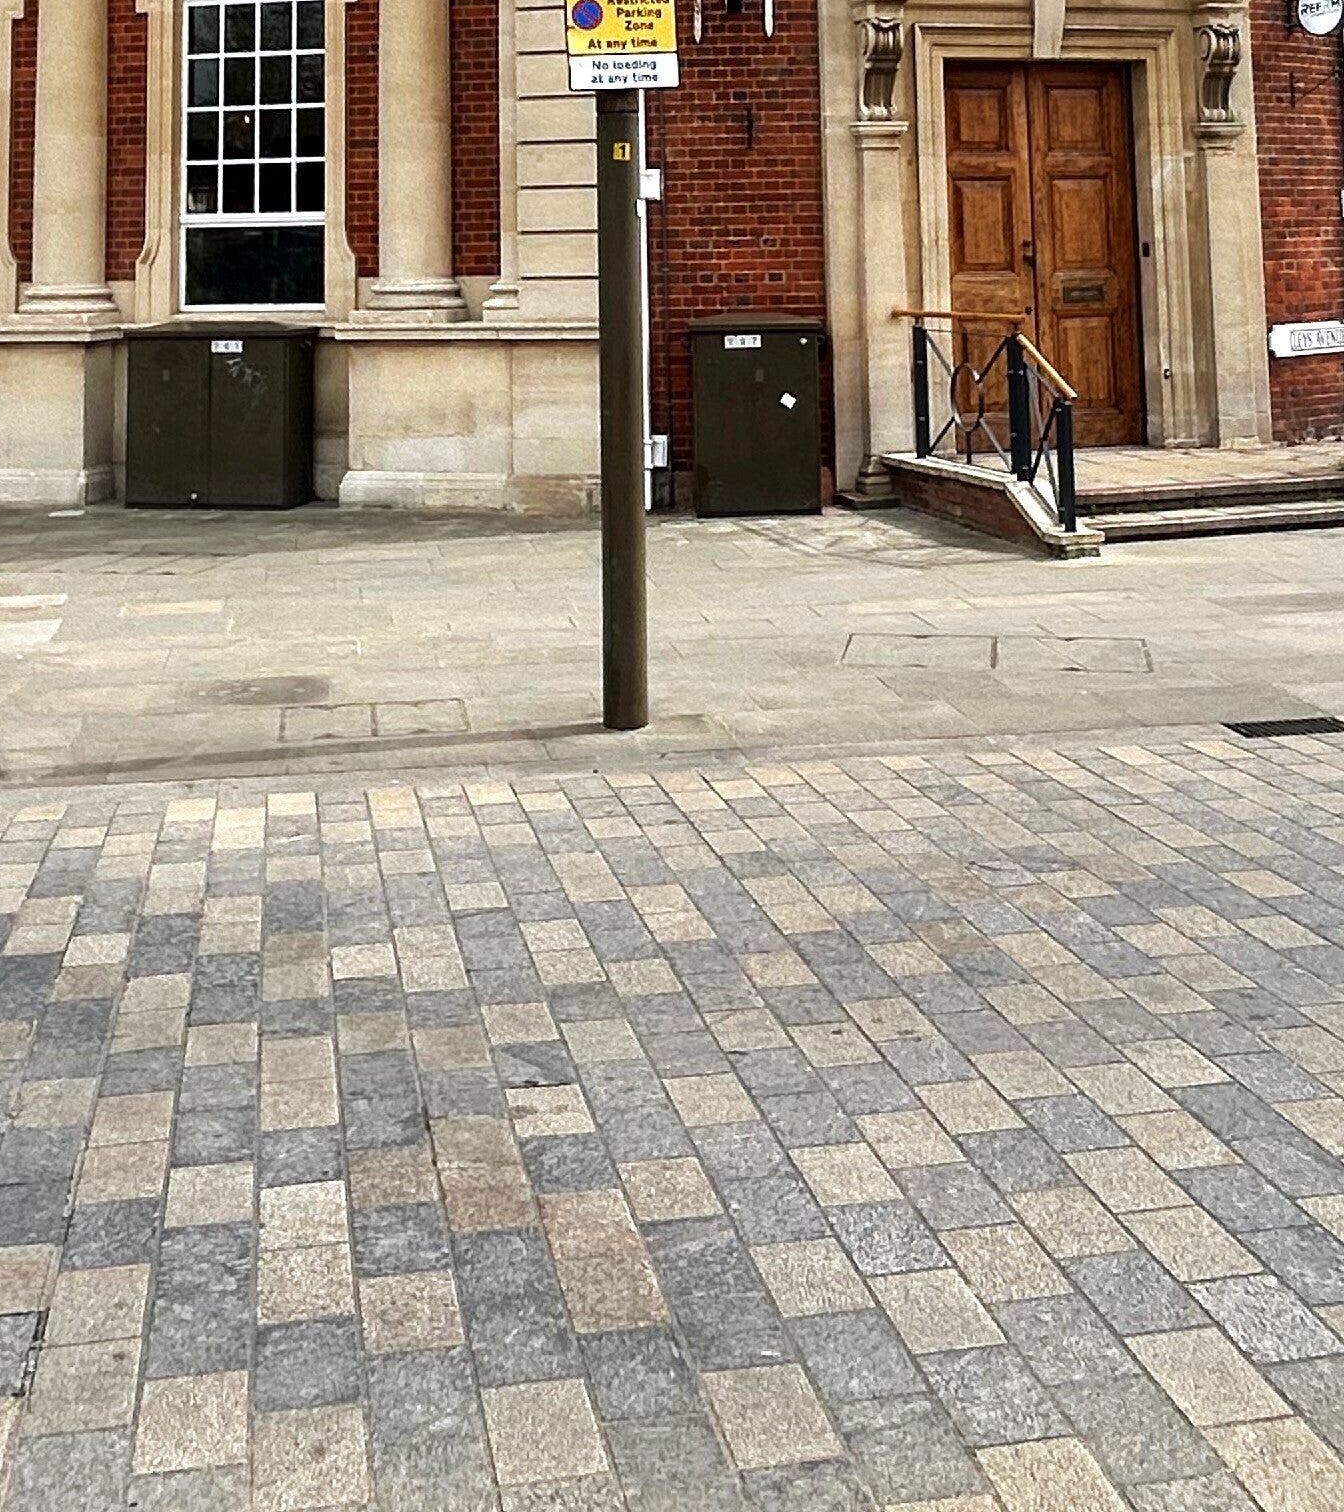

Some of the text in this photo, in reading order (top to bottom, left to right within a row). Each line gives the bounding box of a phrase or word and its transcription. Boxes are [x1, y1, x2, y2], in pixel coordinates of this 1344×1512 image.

[616, 7, 662, 18] Parking
[624, 20, 654, 31] Zone
[587, 37, 658, 50] At any time
[592, 59, 657, 70] No loading
[591, 73, 658, 84] at any time
[618, 144, 626, 159] 1
